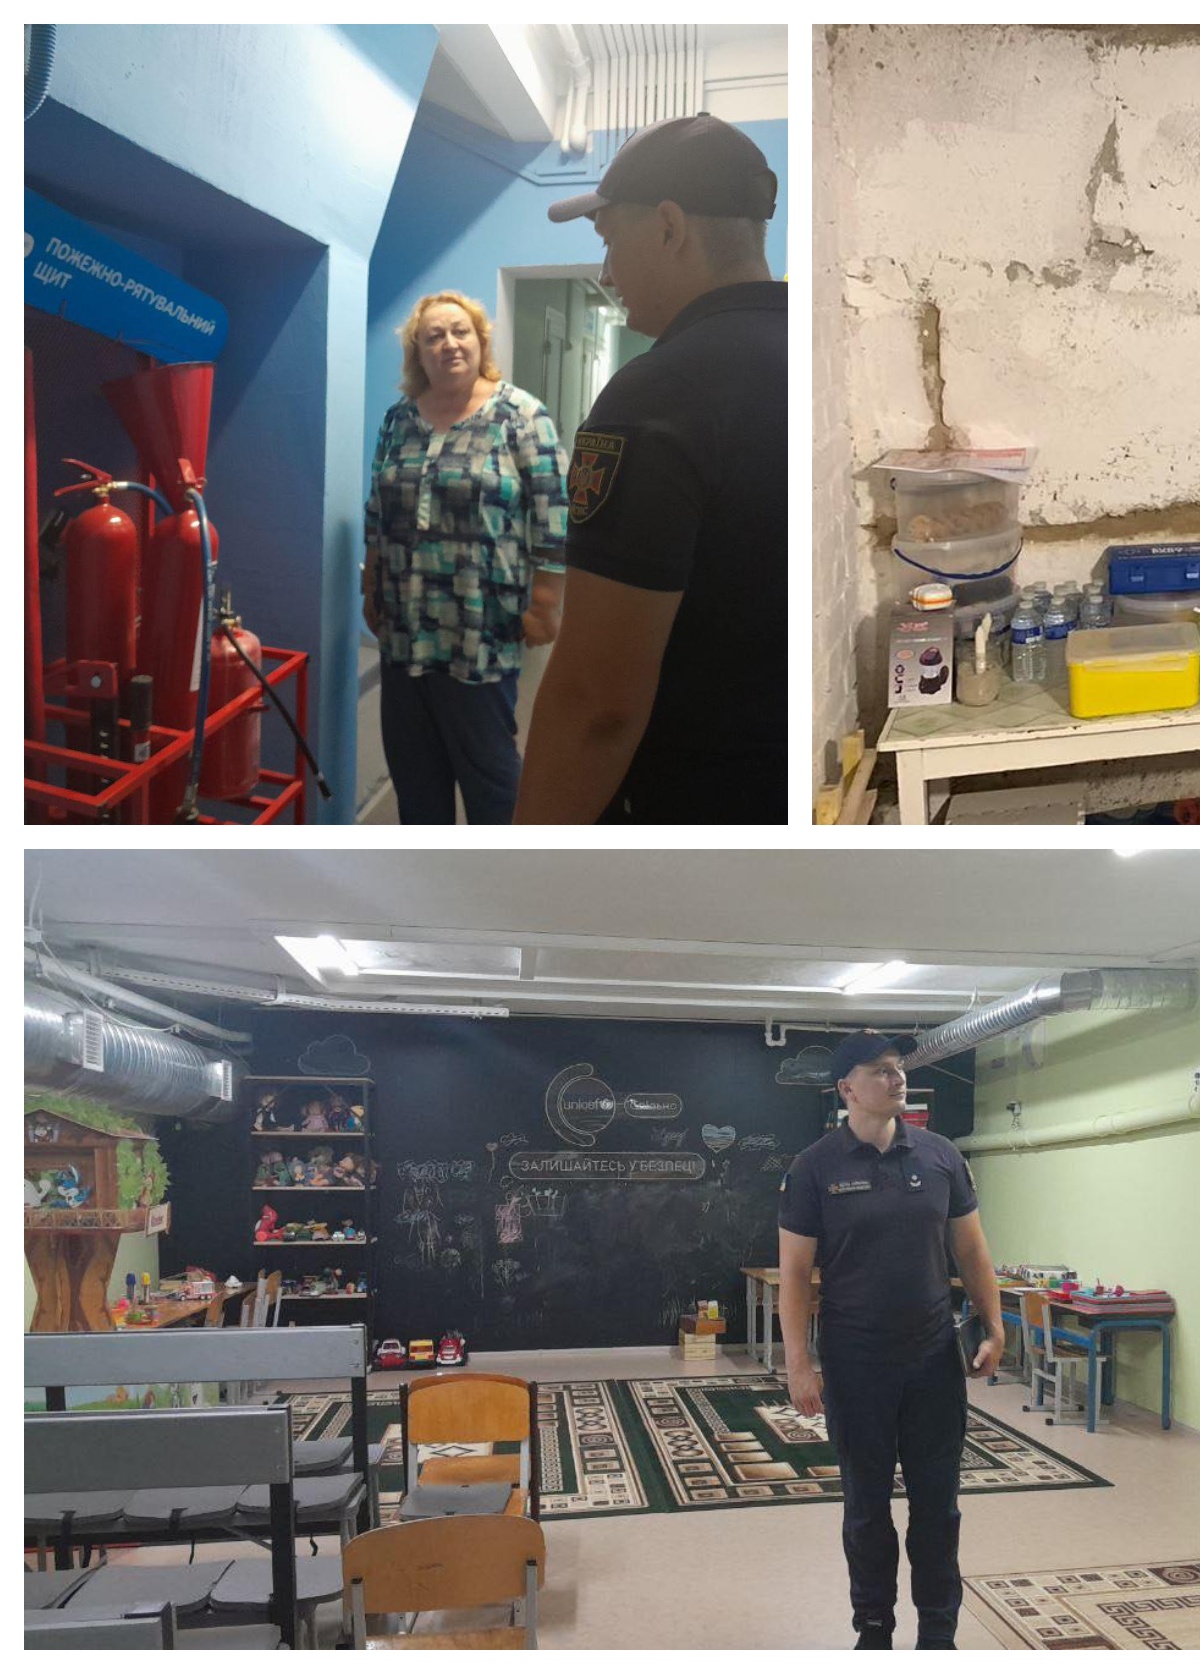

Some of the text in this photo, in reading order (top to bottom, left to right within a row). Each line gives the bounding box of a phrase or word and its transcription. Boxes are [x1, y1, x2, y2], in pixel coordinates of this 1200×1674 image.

[33, 261, 73, 289] ЩИТ
[45, 237, 216, 336] ПОЖЕЖНО-РЯТУВАЛЬНИЙ
[563, 1098, 601, 1111] unicef
[521, 1158, 696, 1174] ЗАЛИШАЙТЕСЬ У БЕЗПЕЦІ
